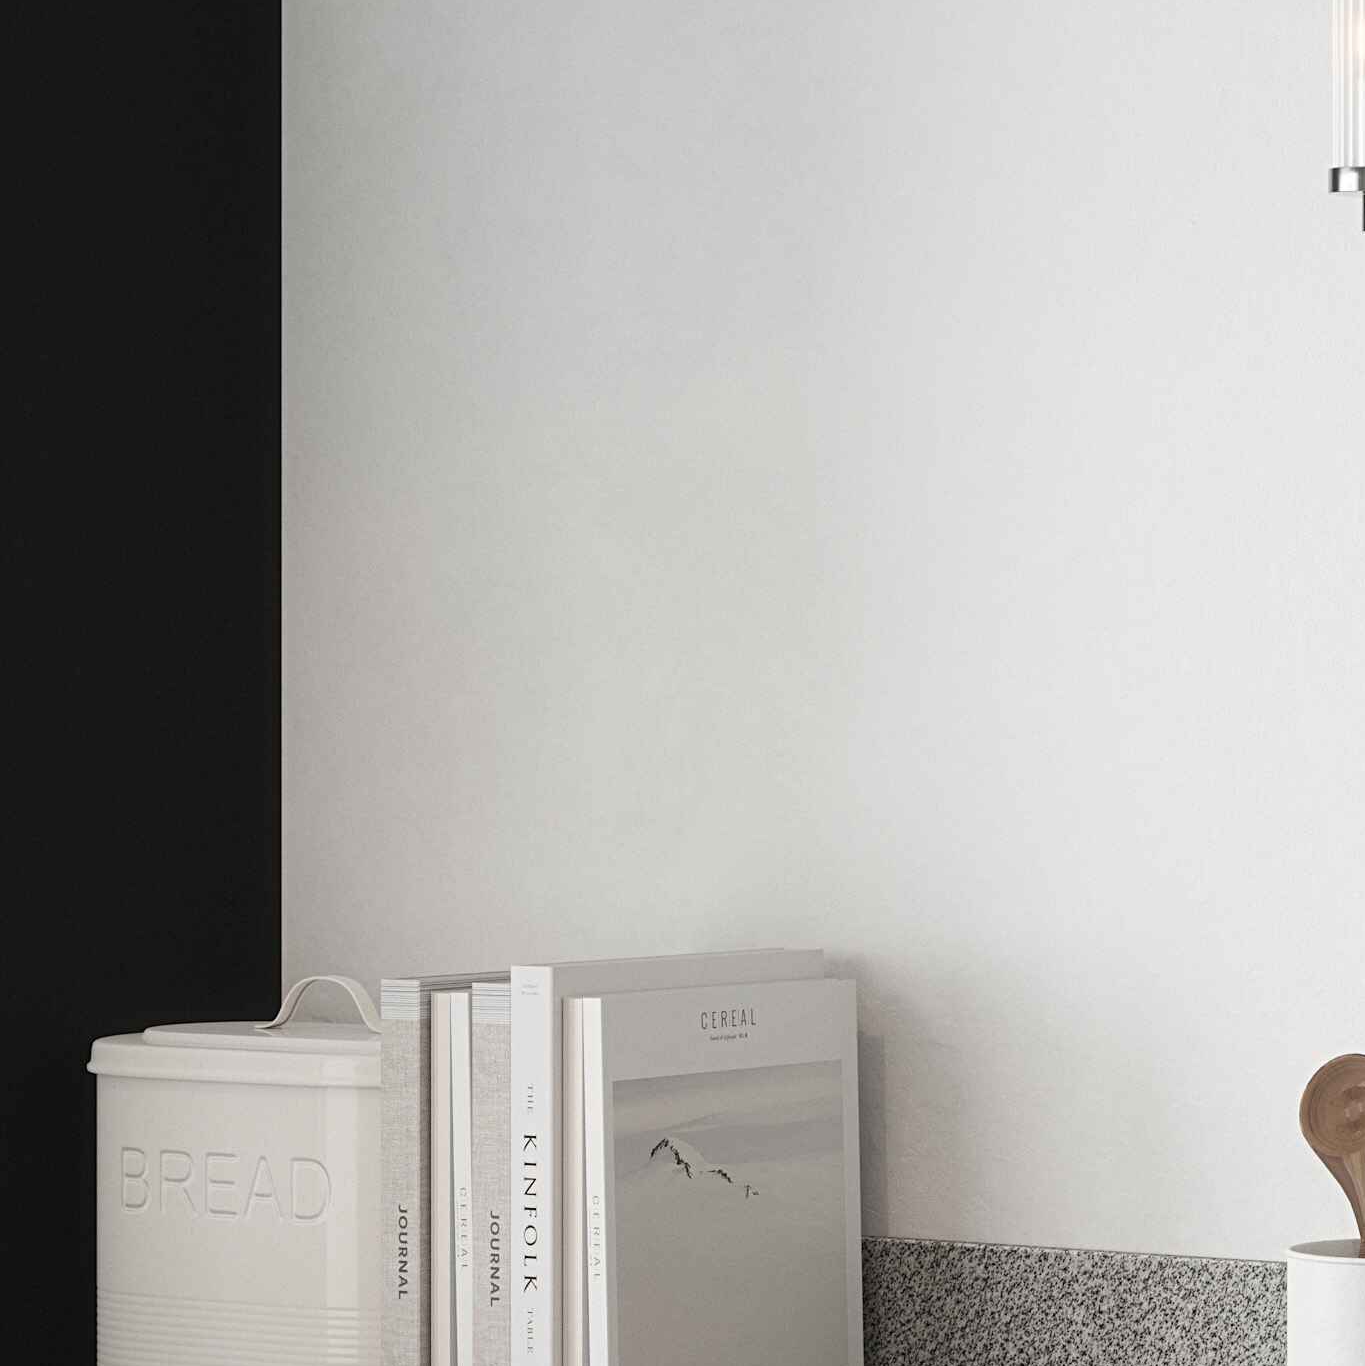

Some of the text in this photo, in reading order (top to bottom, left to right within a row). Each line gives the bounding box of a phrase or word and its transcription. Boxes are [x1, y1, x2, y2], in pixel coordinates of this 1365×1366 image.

[700, 1007, 757, 1030] CEREAL
[121, 1146, 333, 1220] BREAD
[522, 1135, 538, 1292] KINFOLK
[398, 1204, 409, 1300] JOURNAL
[489, 1210, 500, 1307] JOURNAL
